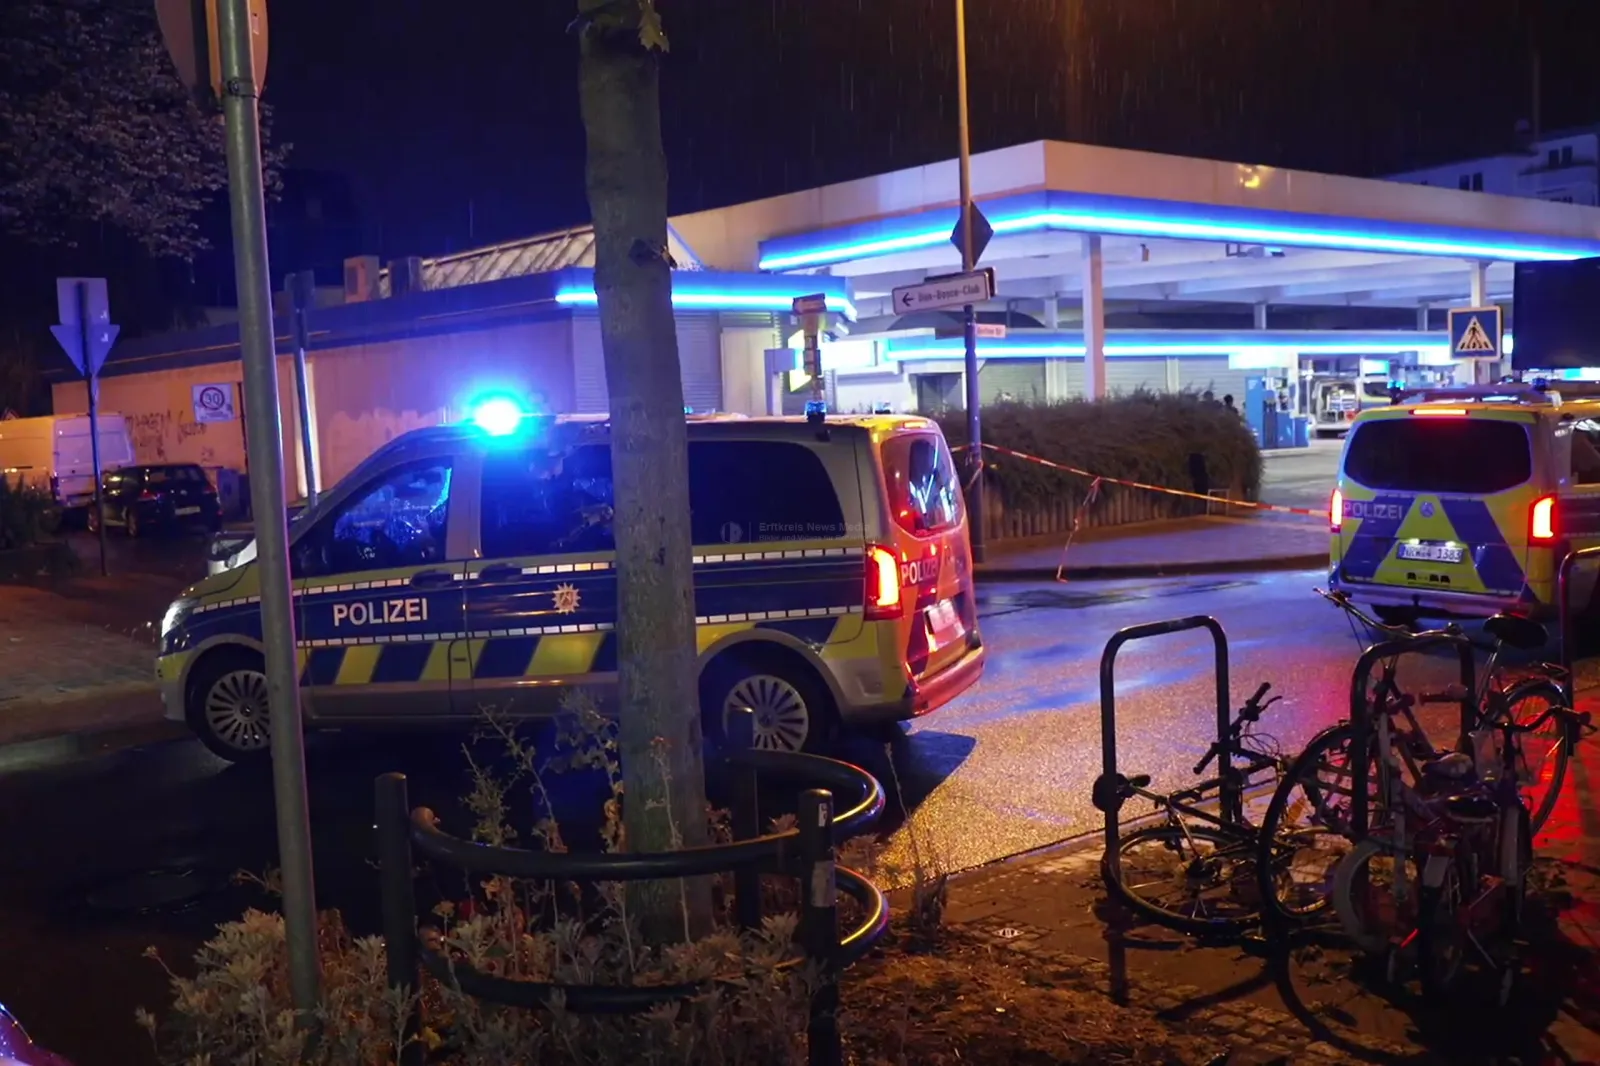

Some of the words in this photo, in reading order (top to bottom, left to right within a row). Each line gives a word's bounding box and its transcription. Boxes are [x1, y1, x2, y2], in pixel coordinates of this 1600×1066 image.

[203, 392, 220, 405] 30
[1343, 502, 1402, 519] POLIZEI
[333, 598, 428, 627] POLIZEI
